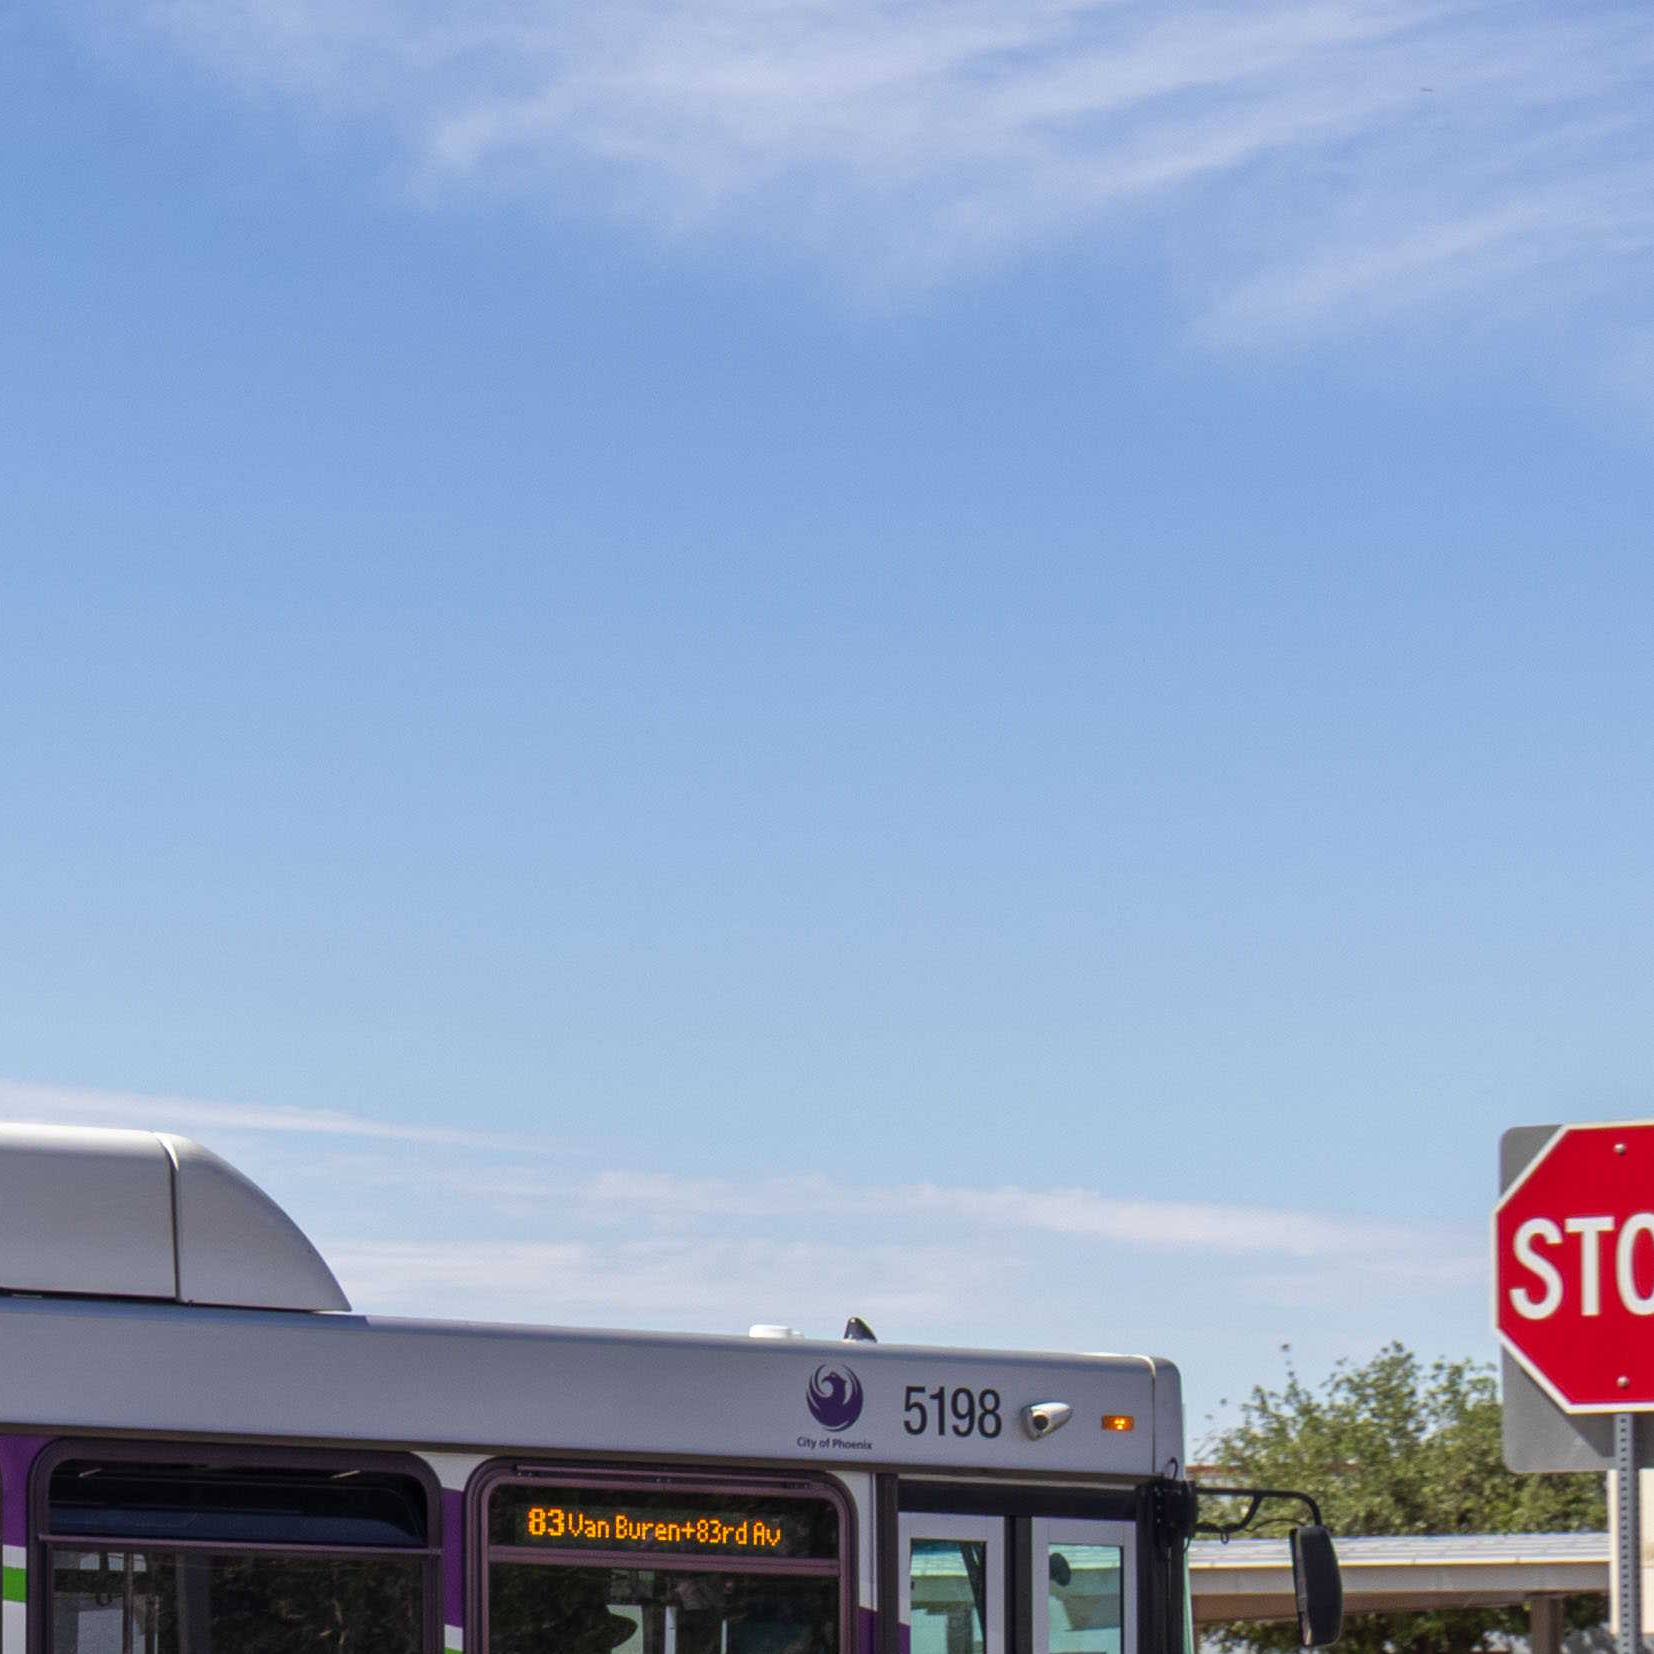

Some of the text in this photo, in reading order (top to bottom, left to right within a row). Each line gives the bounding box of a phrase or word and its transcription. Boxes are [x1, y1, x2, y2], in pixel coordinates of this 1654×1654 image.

[903, 1385, 1002, 1439] 5198
[796, 1436, 873, 1450] City of Phoenix
[527, 1507, 565, 1537] 83
[567, 1511, 610, 1539] Van
[752, 1520, 781, 1547] Av
